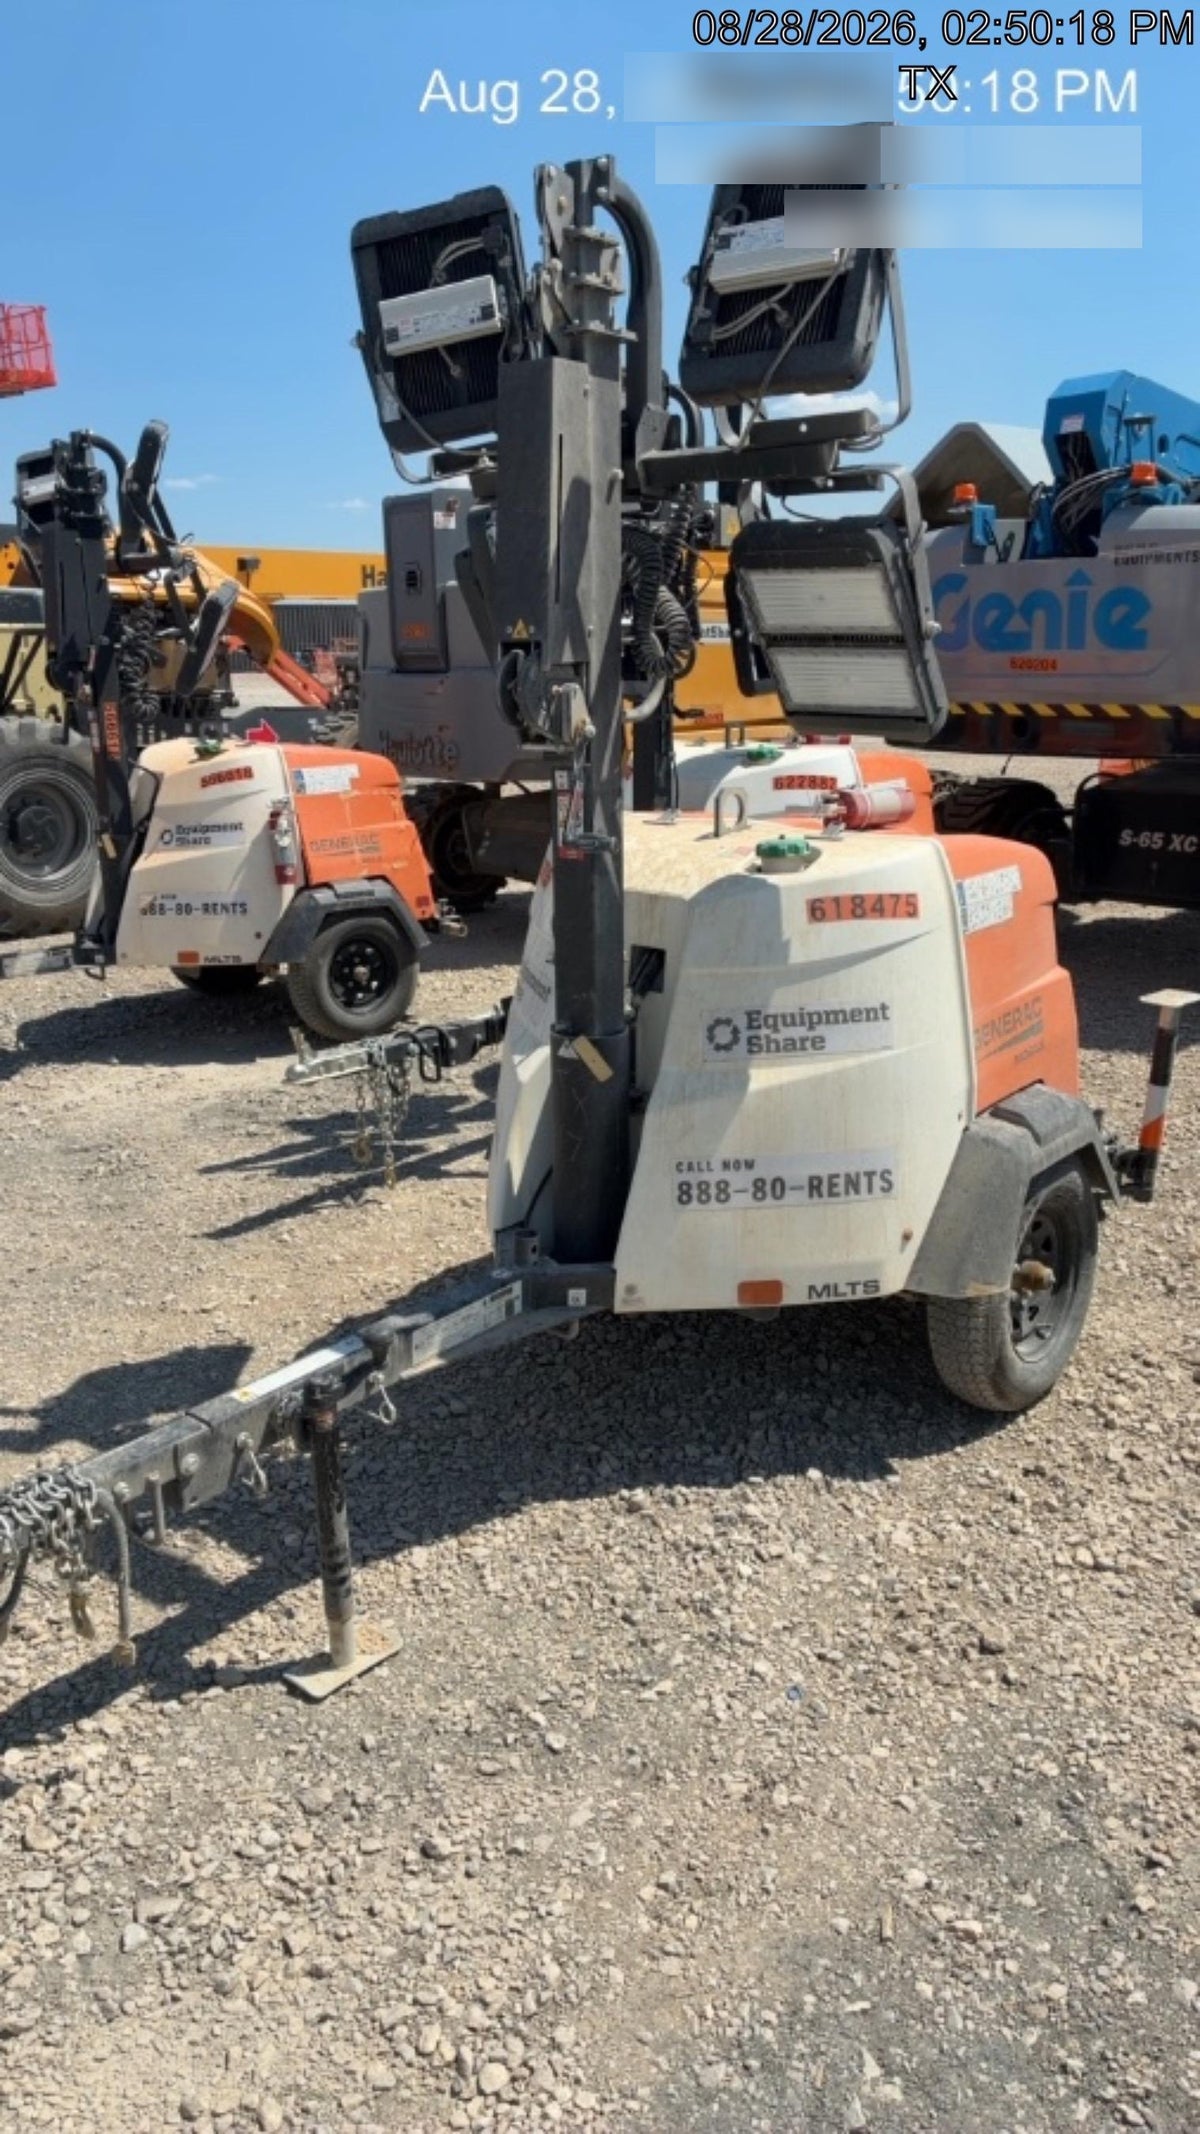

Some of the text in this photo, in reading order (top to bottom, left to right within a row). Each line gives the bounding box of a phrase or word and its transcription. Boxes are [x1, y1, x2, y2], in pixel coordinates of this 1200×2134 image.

[933, 567, 1151, 652] Genie
[1119, 828, 1199, 852] S-65 XC
[809, 893, 919, 923] 618475
[744, 1002, 890, 1034] Equipment
[746, 1033, 826, 1055] Share
[675, 1158, 756, 1173] CALL NOW
[677, 1169, 894, 1206] 888-80-RENTS
[807, 1279, 881, 1300] MLTS
